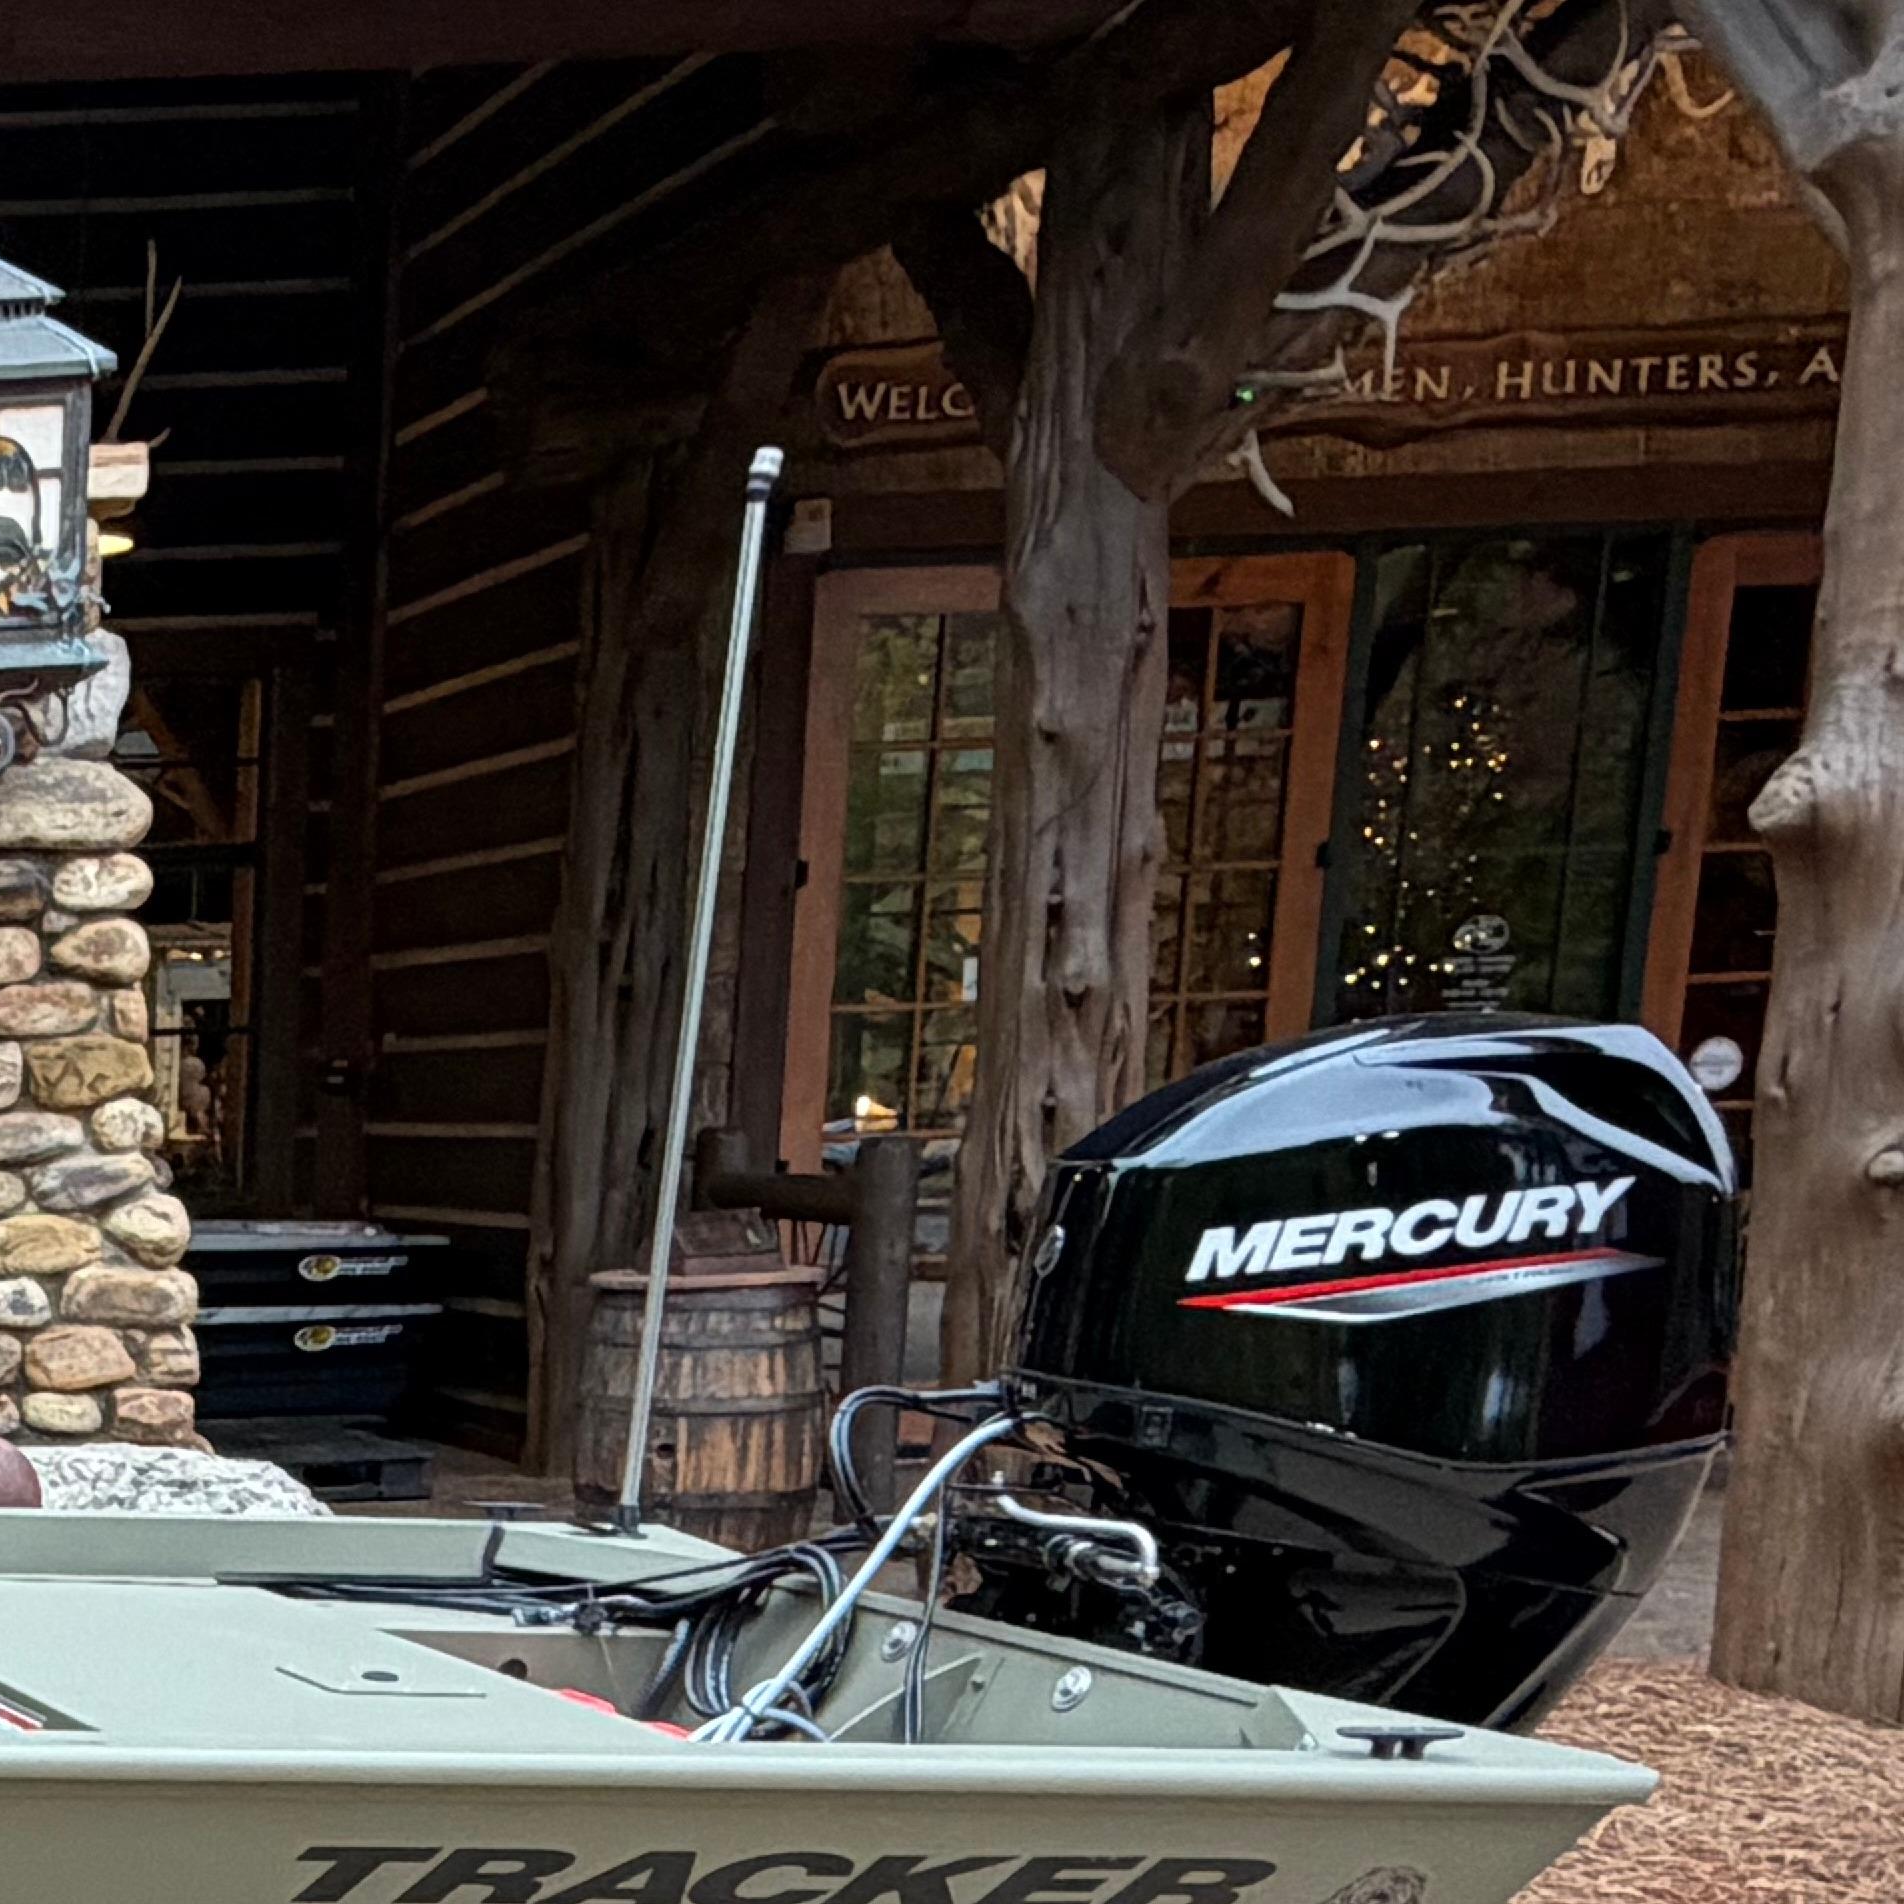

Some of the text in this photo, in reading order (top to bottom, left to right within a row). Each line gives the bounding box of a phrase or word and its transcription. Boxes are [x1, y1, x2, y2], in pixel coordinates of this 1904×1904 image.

[837, 381, 976, 421] WELC
[1495, 350, 1782, 401] HUNTERS,
[1184, 1176, 1637, 1282] MERCURY
